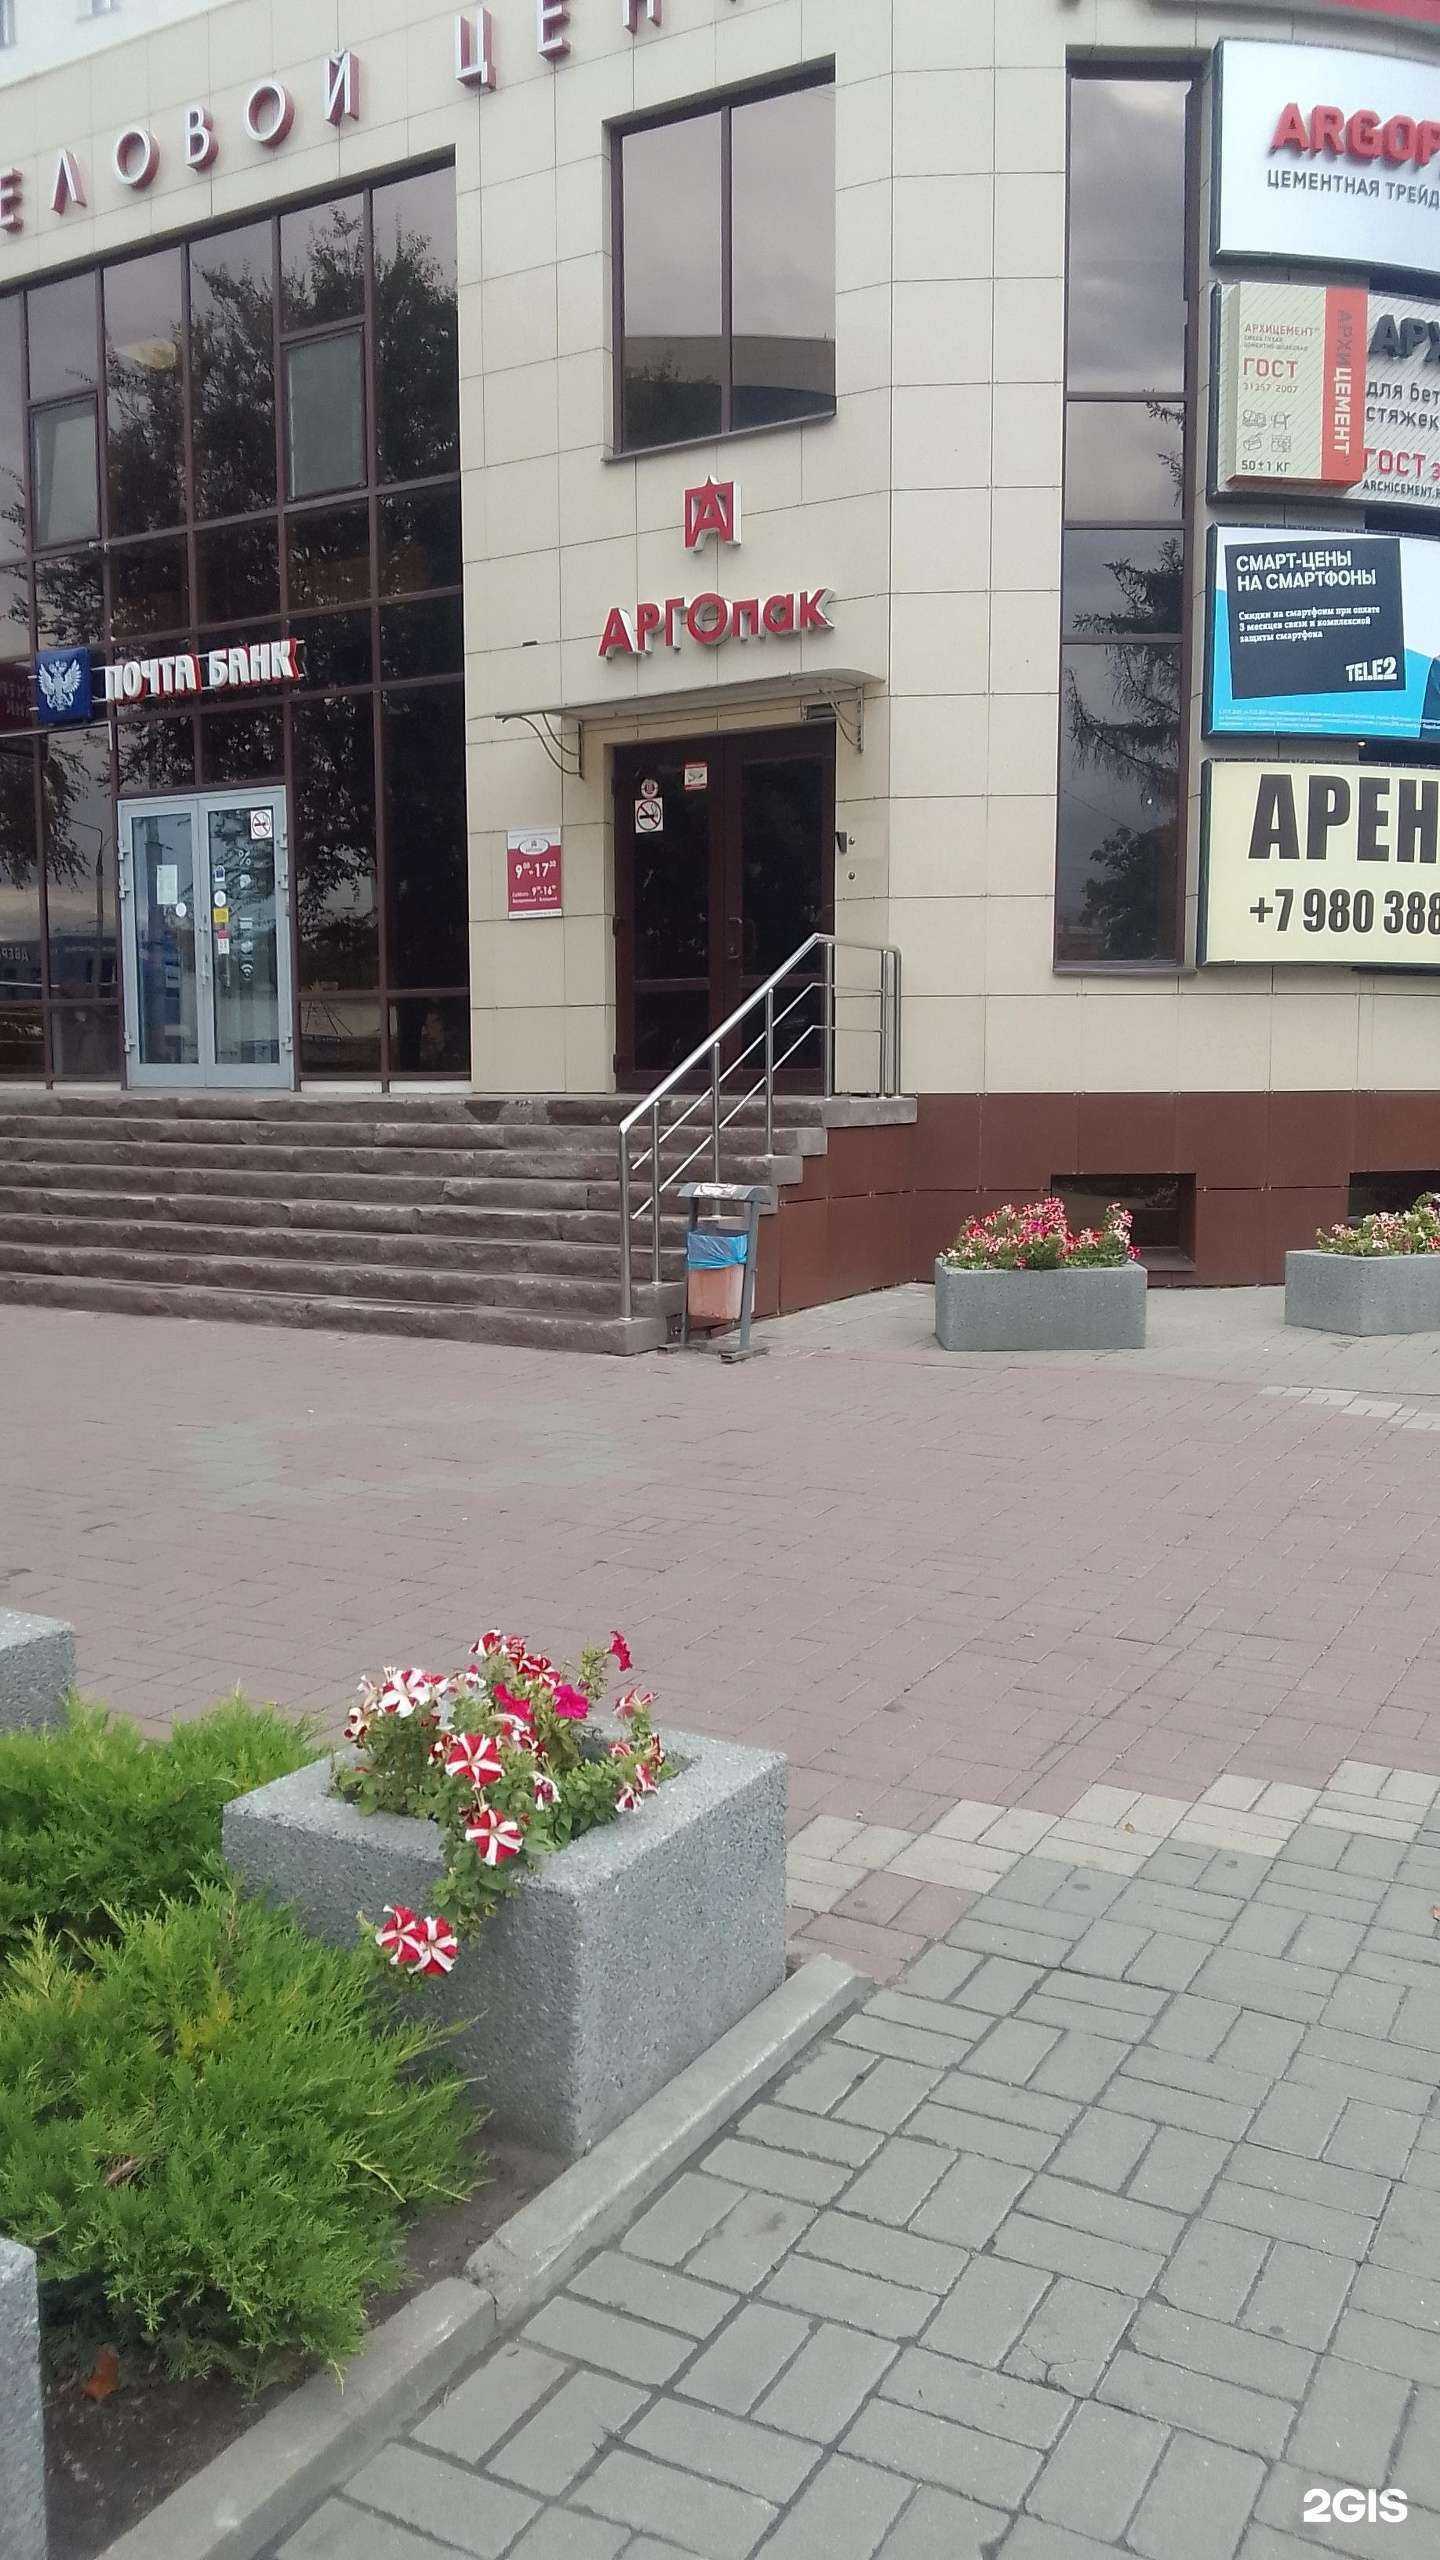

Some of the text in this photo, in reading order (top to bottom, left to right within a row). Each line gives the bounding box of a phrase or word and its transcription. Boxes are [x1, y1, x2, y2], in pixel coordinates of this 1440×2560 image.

[1267, 169, 1380, 198] ЦЕМЕНТНАЯ
[1243, 357, 1298, 379] ГОСТ
[1366, 382, 1403, 400] для
[1366, 406, 1439, 431] стяжек
[1363, 447, 1427, 479] ГОСТ
[1236, 550, 1352, 572] СМАРТ-ЦЕНЫ
[1237, 569, 1376, 592] НА СМАРТФОНЫ
[105, 638, 301, 706] ПОЧТА БАНК
[1346, 656, 1398, 683] TELE2
[1248, 774, 1439, 864] АРЕН
[1249, 888, 1440, 936] +7 980 388
